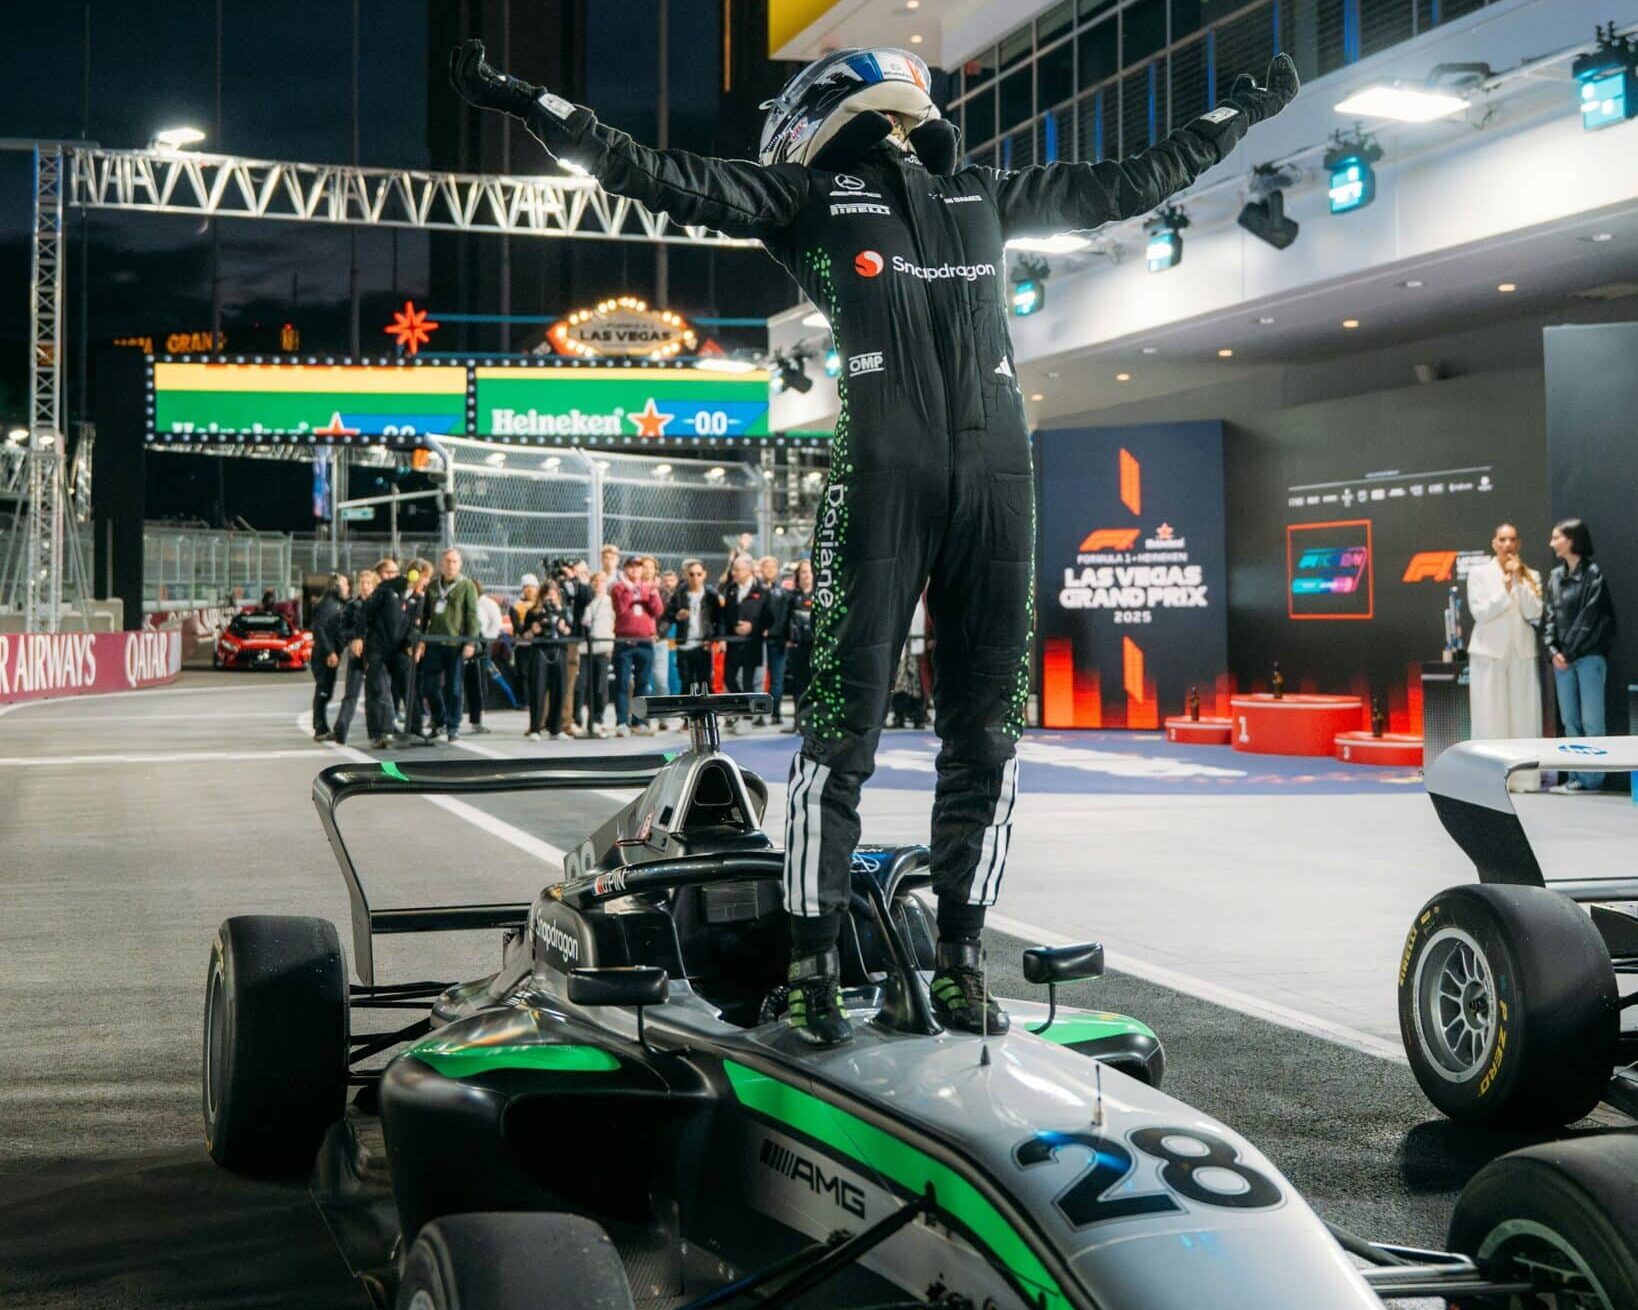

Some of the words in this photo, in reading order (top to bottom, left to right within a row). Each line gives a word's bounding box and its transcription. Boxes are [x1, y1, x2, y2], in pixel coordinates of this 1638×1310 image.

[892, 256, 996, 282] Snapdragon
[580, 330, 611, 341] LAS
[616, 330, 671, 341] VEGAS
[849, 353, 884, 374] OMP
[491, 408, 623, 434] Heineken
[818, 484, 844, 608] Doriane
[1064, 568, 1114, 588] LAS
[1115, 565, 1202, 588] VEGAS
[1059, 587, 1146, 609] GRAND
[1147, 585, 1208, 608] PRIX
[13, 633, 96, 692] AIRWAYS
[125, 633, 167, 688] QATAR
[535, 908, 578, 962] Snapdragon
[790, 1156, 865, 1219] AMG
[1012, 1126, 1288, 1233] 28
